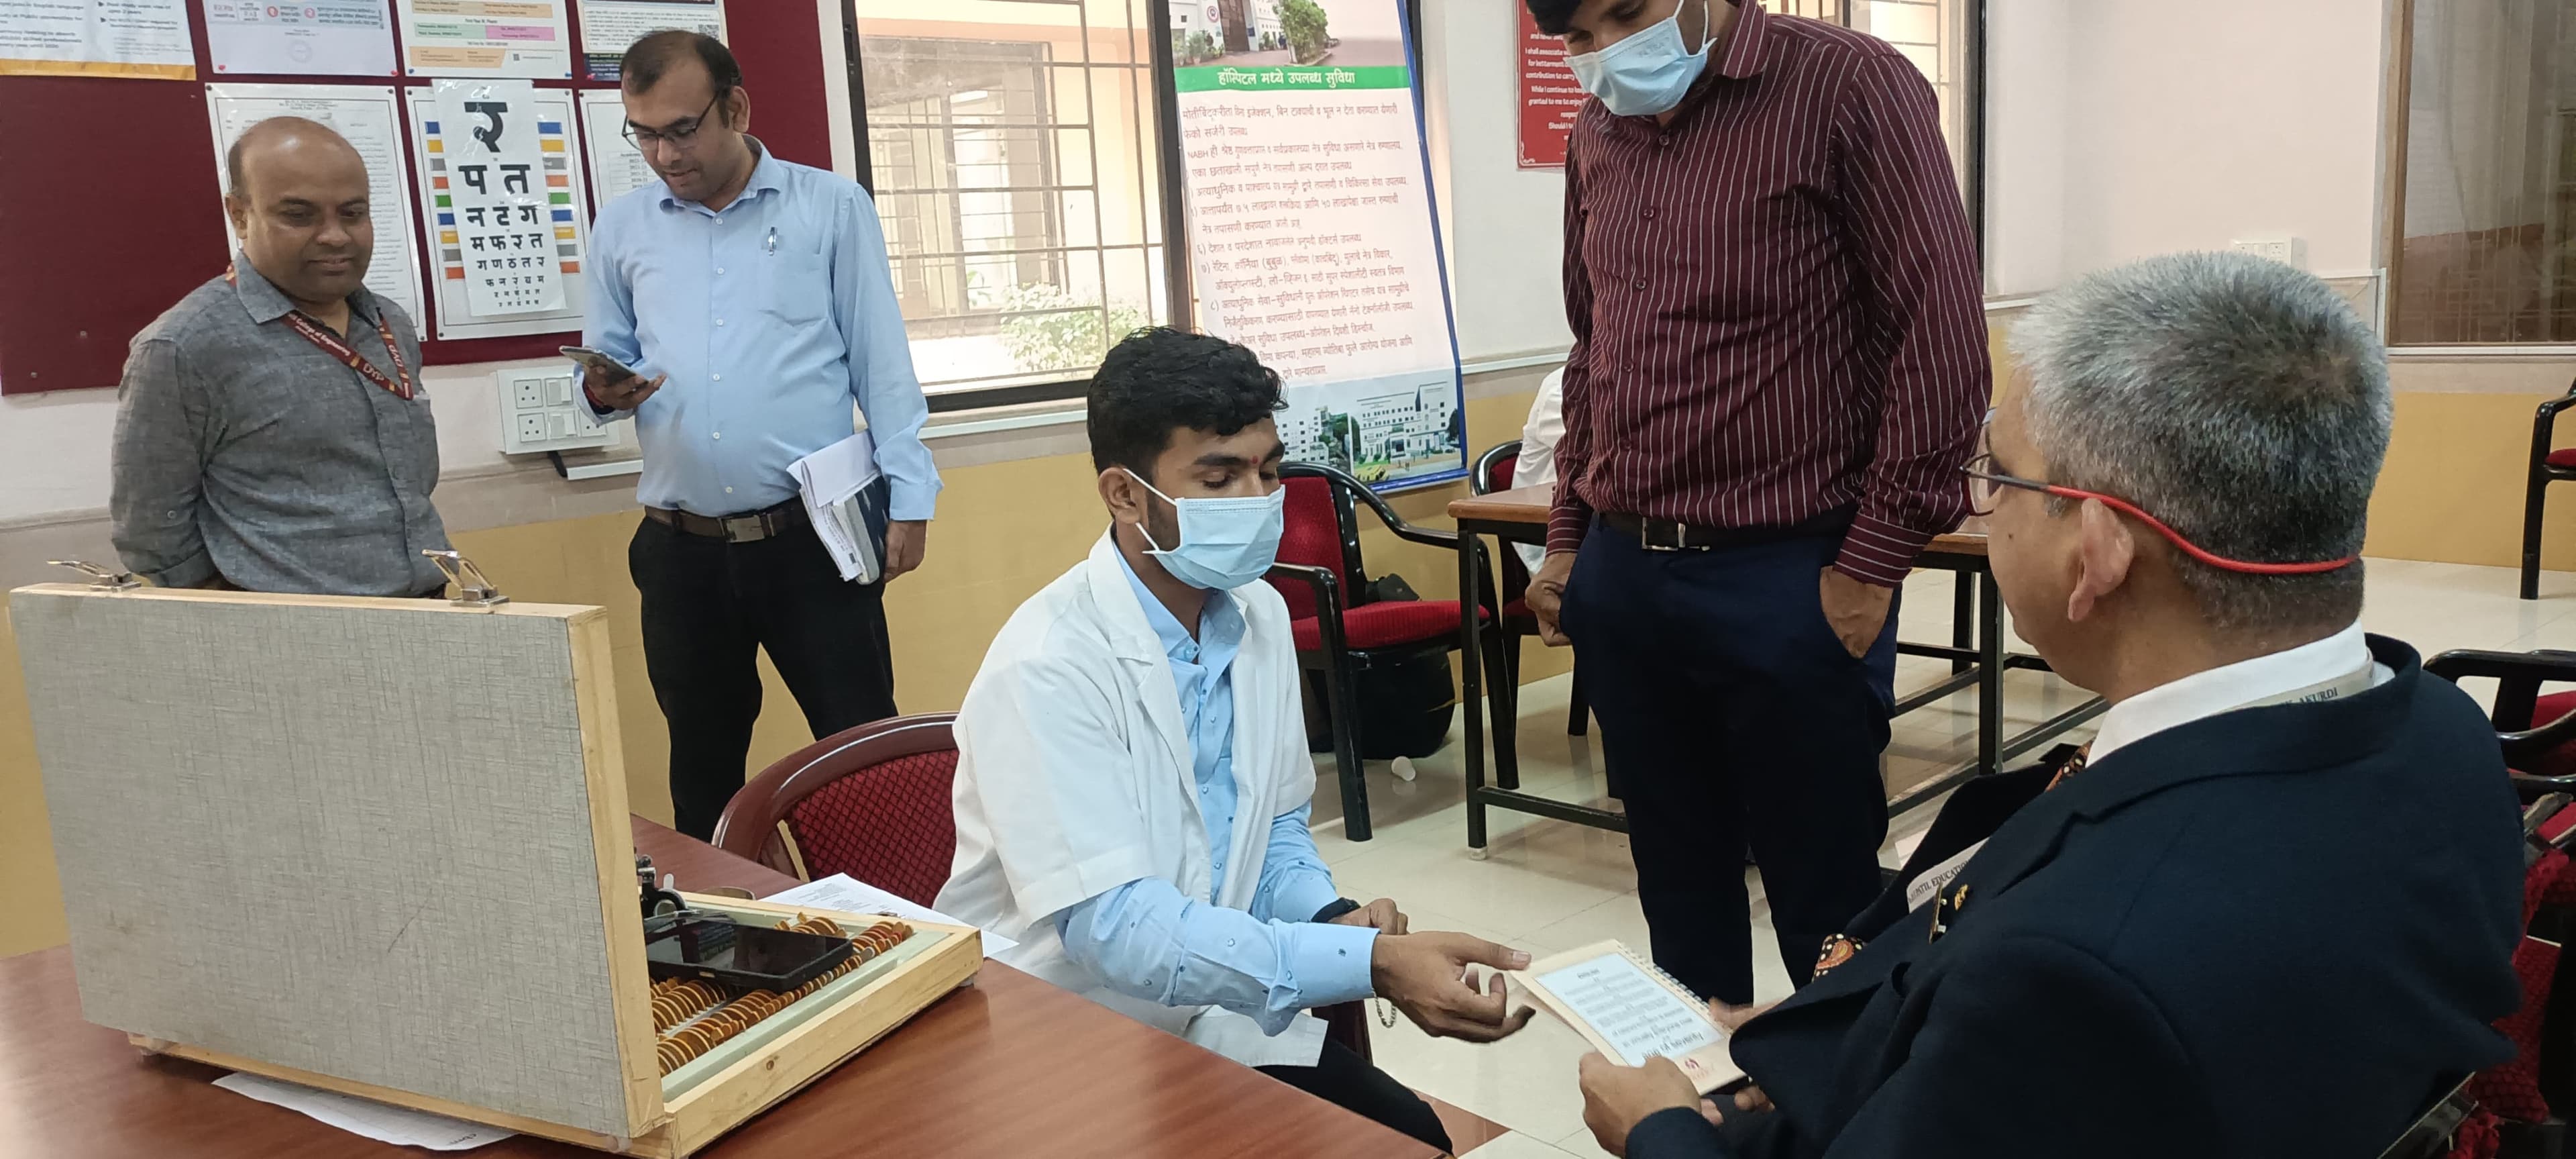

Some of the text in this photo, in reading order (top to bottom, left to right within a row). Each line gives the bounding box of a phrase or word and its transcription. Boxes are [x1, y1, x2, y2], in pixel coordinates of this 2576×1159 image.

[1218, 68, 1355, 88] हॉस्पिटल मध्ये उपलब्ध सुविधा
[464, 102, 508, 152] र
[458, 164, 531, 195] प त
[466, 205, 538, 227] न ट ग
[470, 233, 543, 252] म फ र त
[477, 256, 545, 270] ग ण ठ त र
